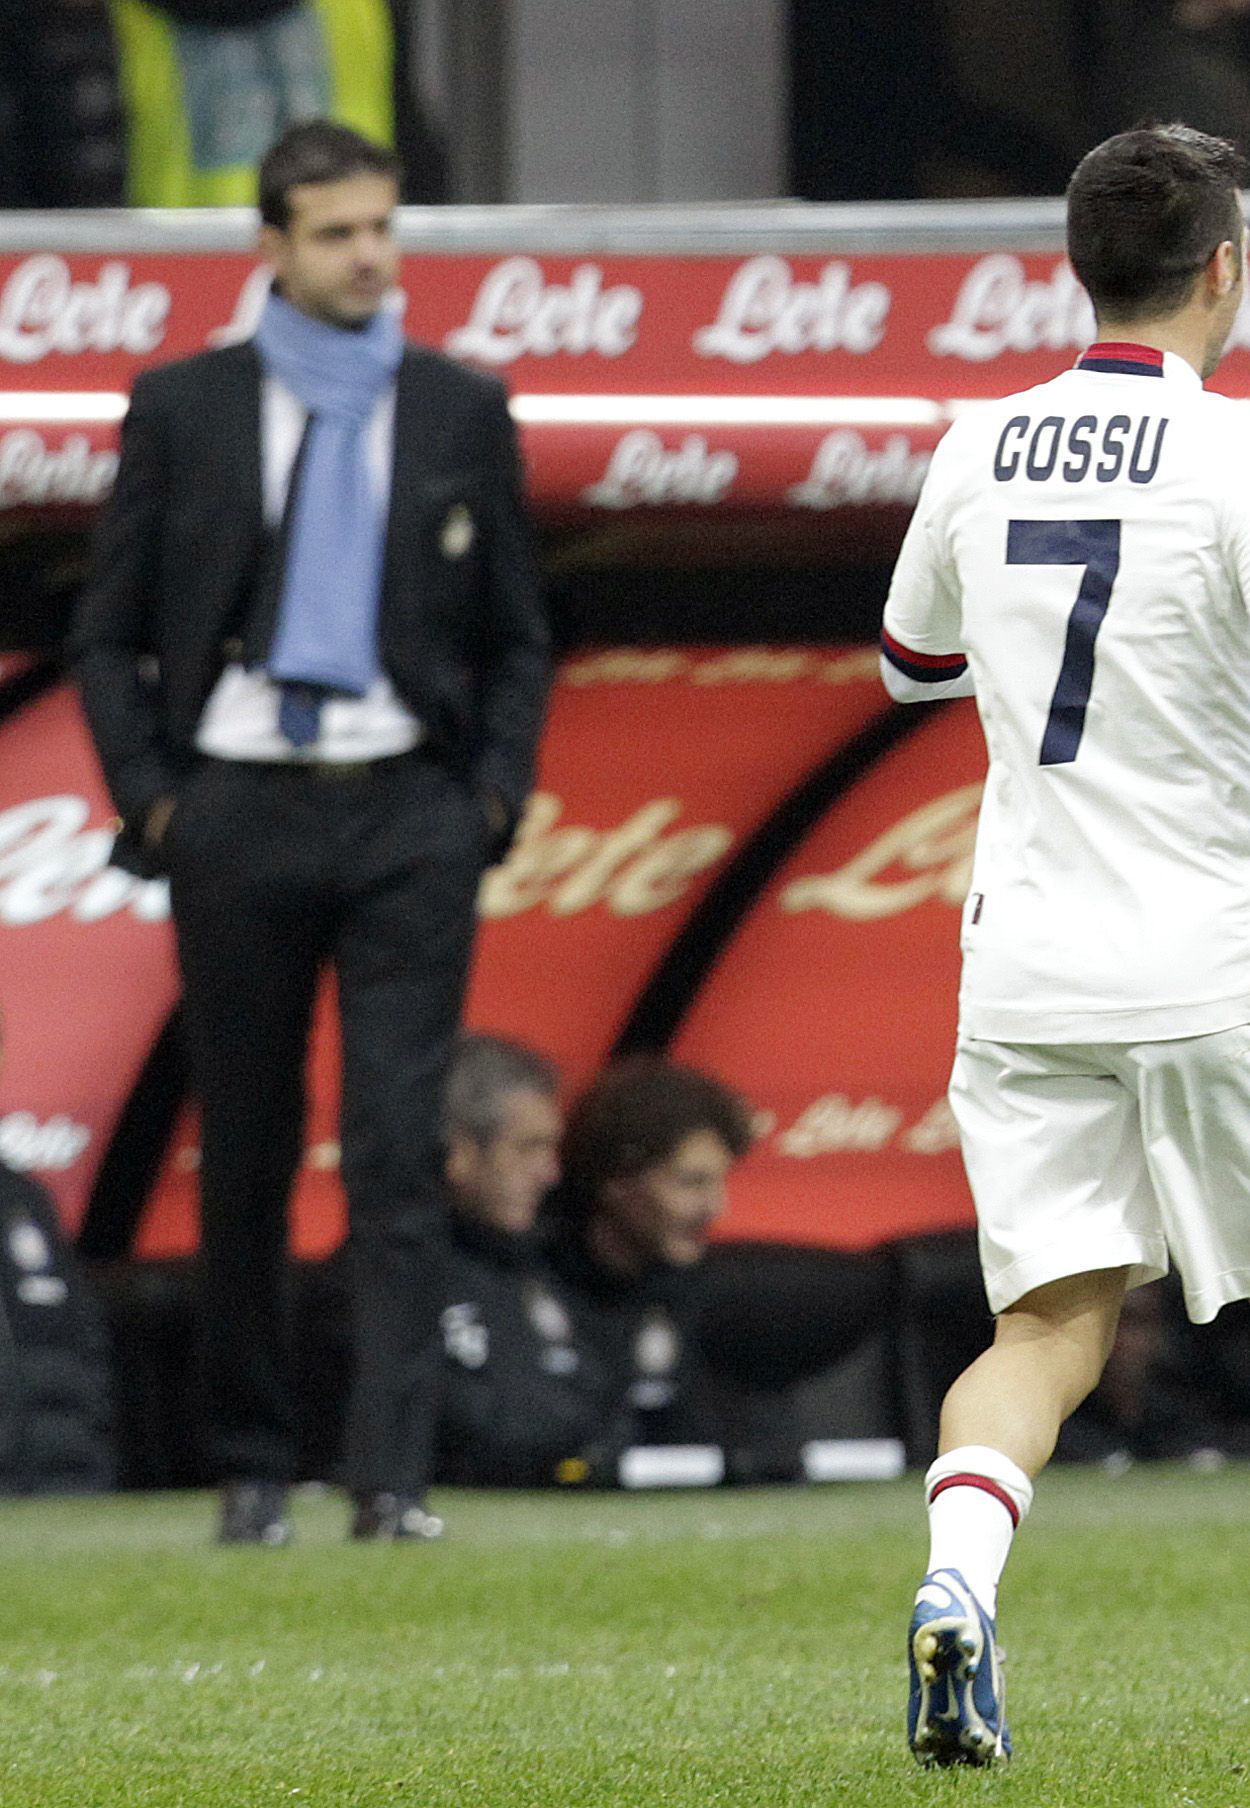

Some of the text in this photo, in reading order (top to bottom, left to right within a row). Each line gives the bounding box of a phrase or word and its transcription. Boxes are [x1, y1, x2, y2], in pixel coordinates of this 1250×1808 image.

[0, 253, 172, 364] Lete
[442, 255, 644, 364] Lete
[691, 255, 892, 363] Lete
[580, 428, 741, 512] Lete
[993, 415, 1169, 484] COSSU
[1005, 518, 1122, 766] 7
